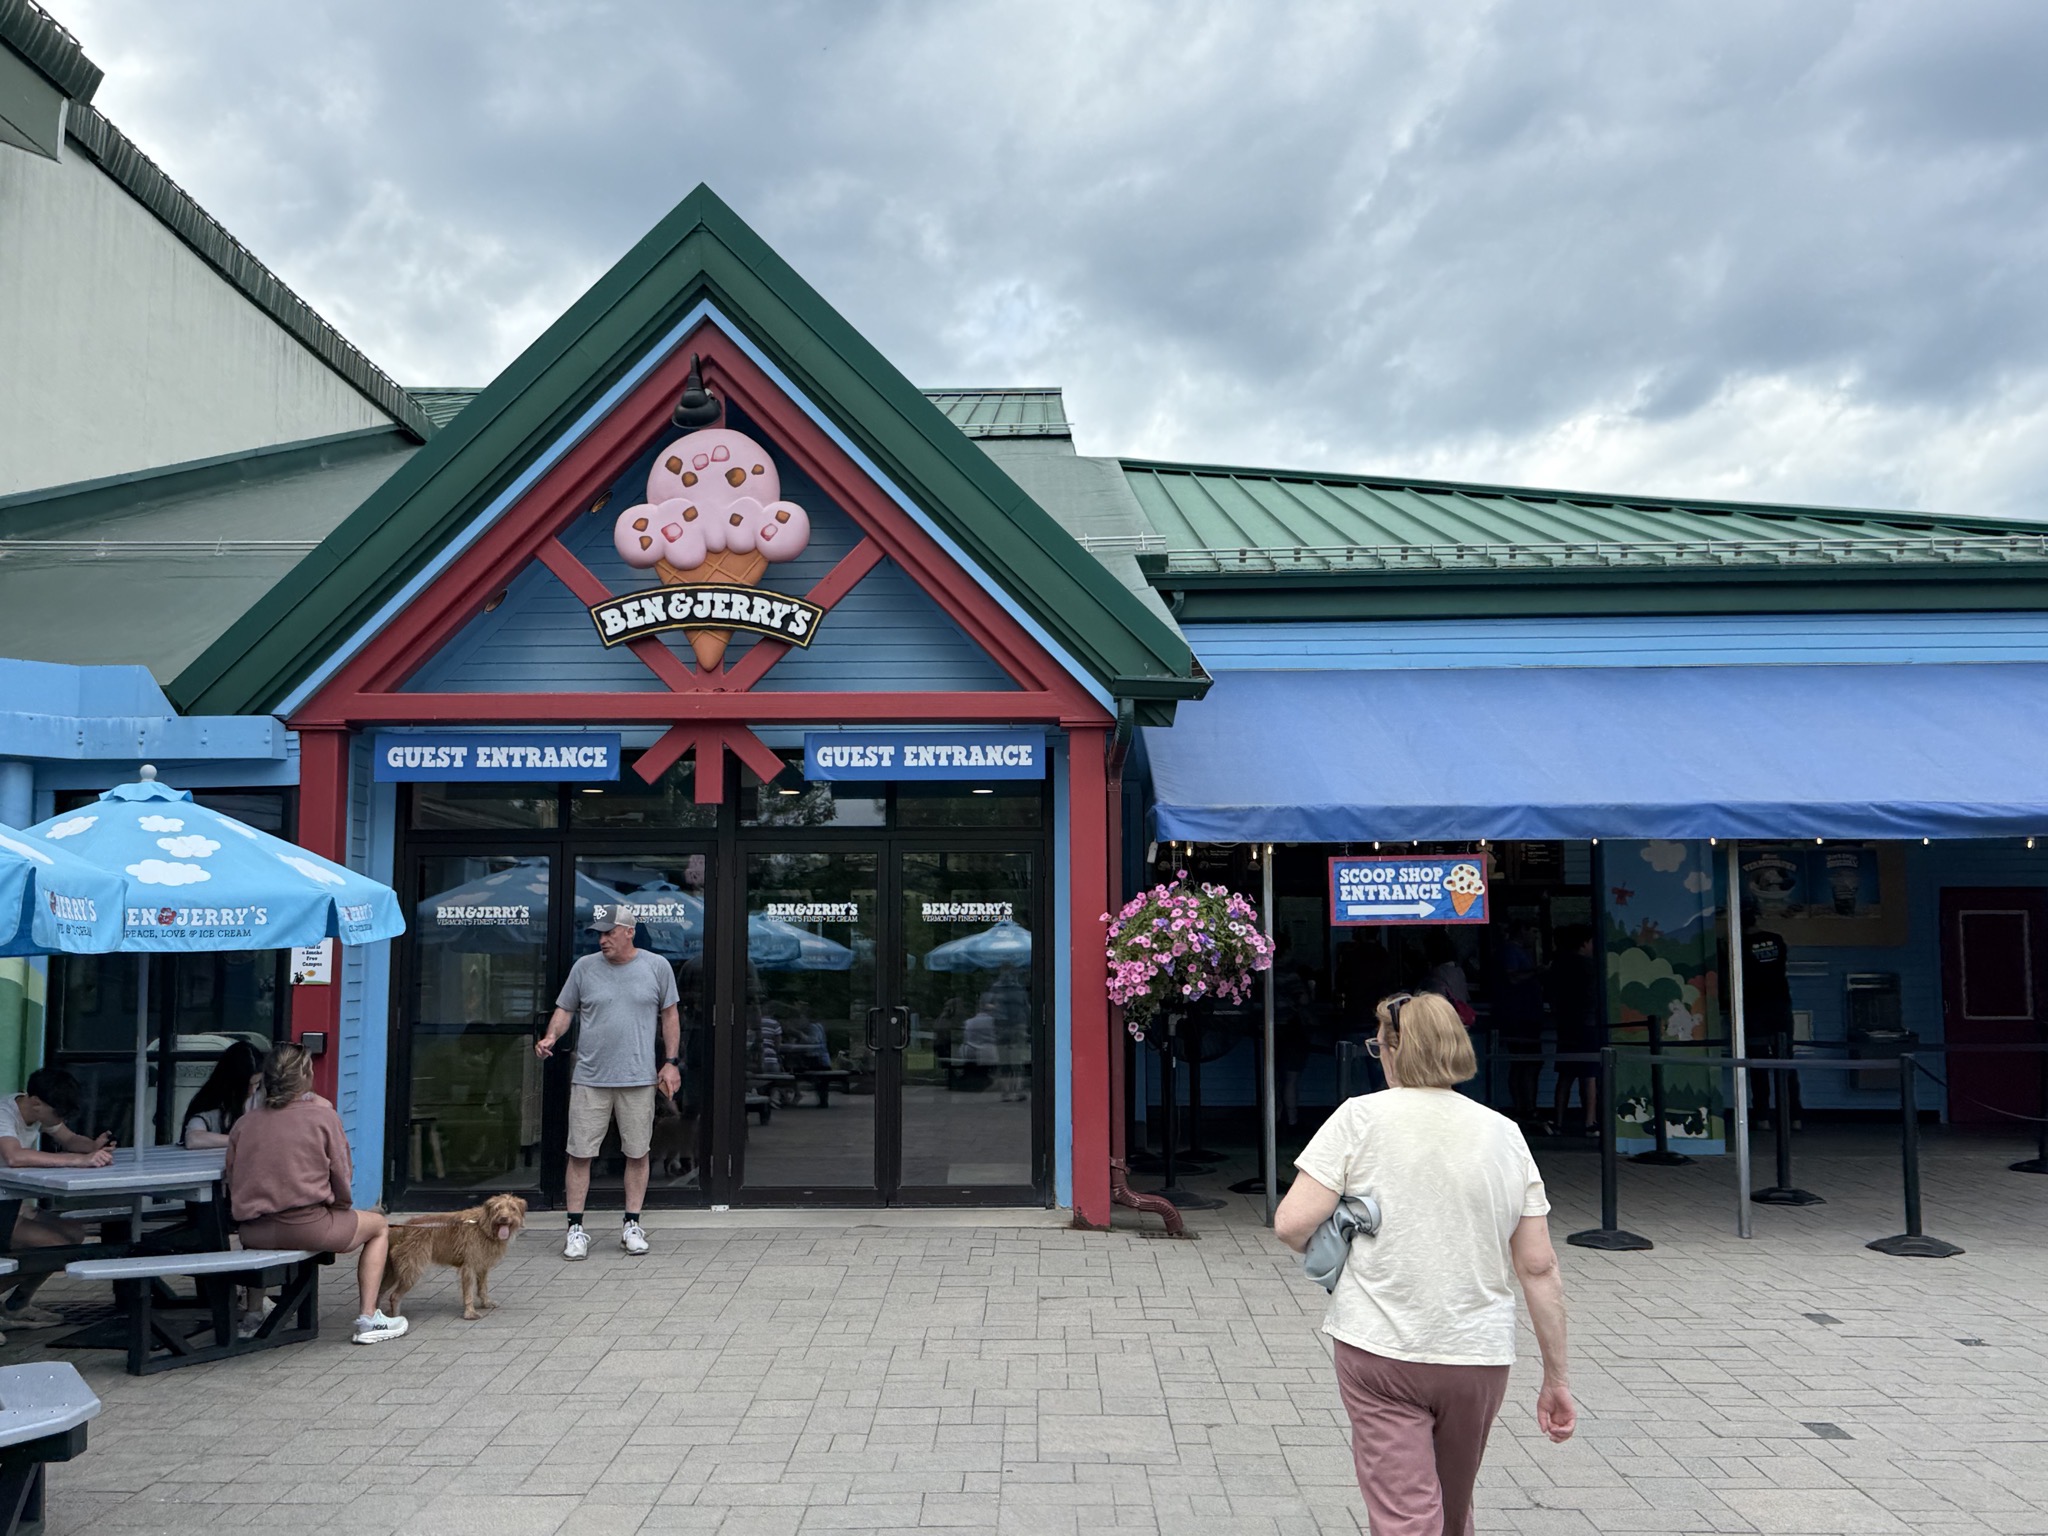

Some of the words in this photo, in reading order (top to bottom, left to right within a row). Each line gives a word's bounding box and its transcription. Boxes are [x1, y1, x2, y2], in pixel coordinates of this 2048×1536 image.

[387, 746, 467, 768] GUEST
[476, 746, 608, 768] ENTRANCE
[816, 746, 895, 767] GUEST
[903, 745, 1033, 767] ENTRANCE
[1339, 868, 1396, 884] SCOOP
[1399, 867, 1443, 883] SHOP
[1340, 884, 1443, 901] ENTRANCE
[127, 905, 268, 926] EN&JERRY'S
[125, 929, 158, 938] PEACE,
[161, 929, 186, 938] LOVE
[189, 929, 197, 938] &
[199, 929, 215, 938] ICE
[217, 929, 252, 938] CREAM
